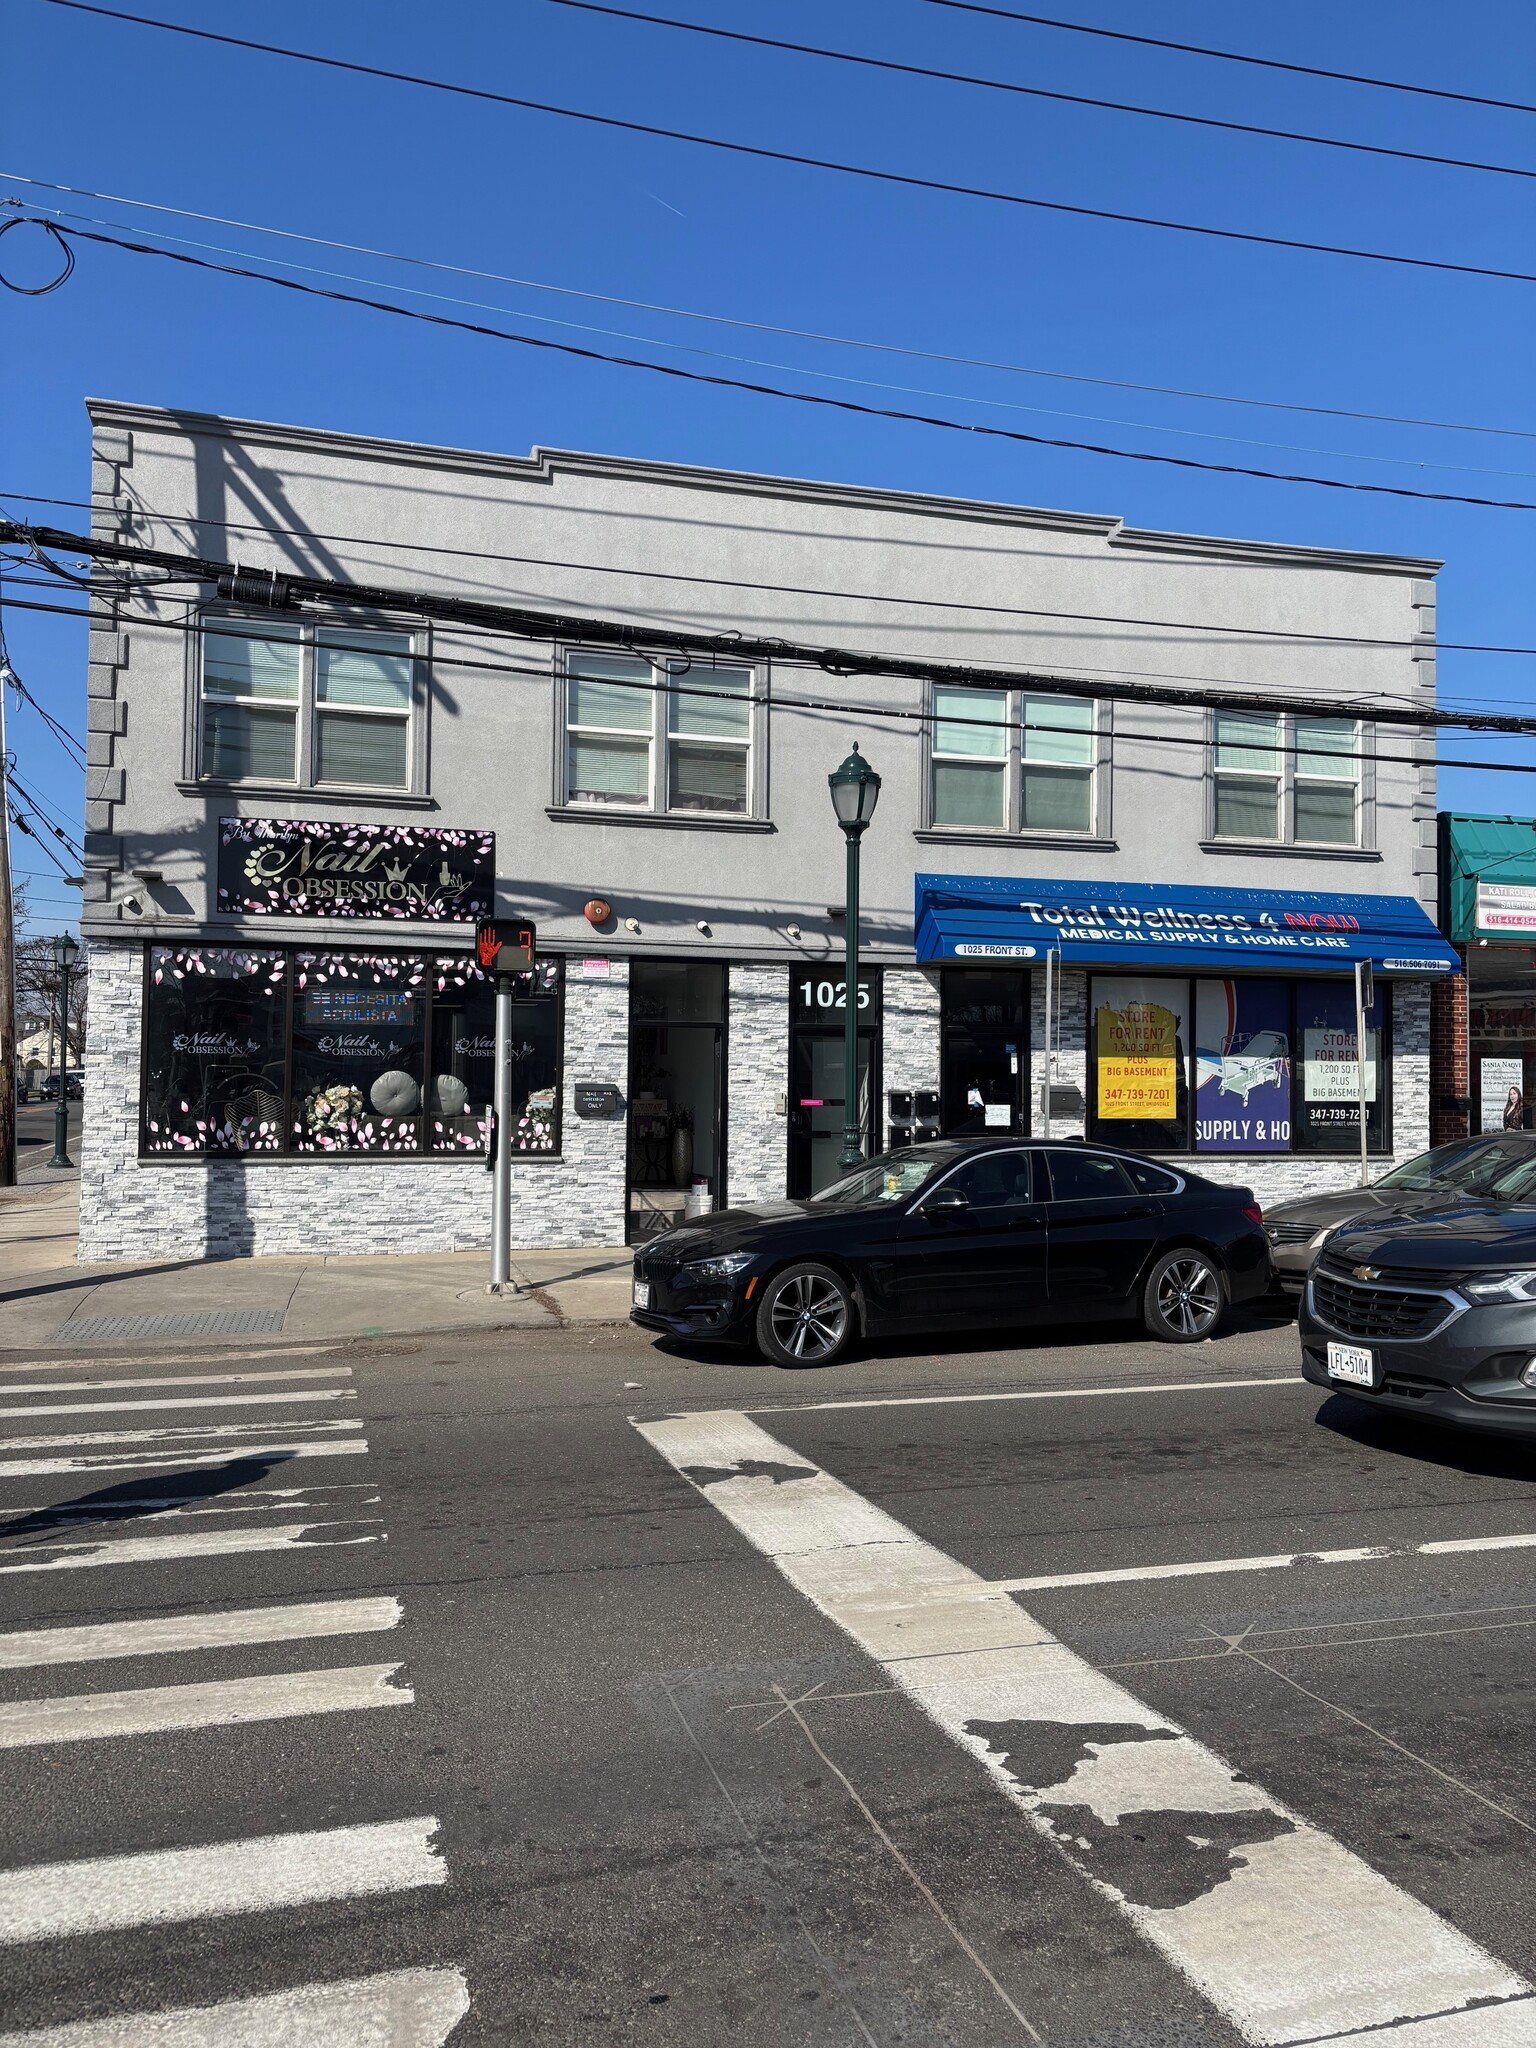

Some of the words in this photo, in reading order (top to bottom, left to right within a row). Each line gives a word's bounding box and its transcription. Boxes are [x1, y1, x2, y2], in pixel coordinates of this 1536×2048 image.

[256, 841, 386, 877] Nail
[282, 877, 428, 901] OBSESSION
[1488, 887, 1507, 896] KATI
[1500, 901, 1527, 910] SALAD
[1019, 902, 1107, 927] Total
[1108, 906, 1252, 931] Wellness
[1259, 912, 1279, 932] 4
[1283, 912, 1361, 935] NOW
[1059, 928, 1149, 942] MEDICAL
[1149, 932, 1219, 944] SUPPLY
[1224, 934, 1242, 945] &
[1242, 935, 1299, 947] HOME
[1299, 936, 1351, 949] CARE
[962, 945, 983, 955] 1025
[984, 945, 1014, 956] FRONT
[1015, 946, 1029, 956] ST.
[800, 981, 870, 1009] 1025
[1119, 1011, 1156, 1023] STORE
[177, 1031, 225, 1048] Nail
[1109, 1027, 1131, 1039] FOR
[1135, 1027, 1165, 1040] RENT
[322, 1034, 370, 1049] Nail
[459, 1035, 496, 1050] Nai
[1323, 1034, 1358, 1046] STORE
[187, 1046, 244, 1055] OBSESSION
[331, 1047, 386, 1057] OBSESSION
[468, 1049, 519, 1057] OBSESN
[1114, 1043, 1136, 1053] 1,200
[1139, 1043, 1150, 1053] SQ
[1152, 1043, 1161, 1052] FT
[1127, 1056, 1148, 1064] PLUS
[1314, 1049, 1335, 1061] FOR
[1338, 1050, 1359, 1061] REN
[1106, 1067, 1121, 1076] BIG
[1124, 1067, 1168, 1076] BASEMENT
[1319, 1064, 1339, 1074] 1,200
[1341, 1064, 1351, 1074] SQ
[1330, 1076, 1350, 1086] PLUS
[1105, 1088, 1170, 1100] 347-739-7201
[1312, 1088, 1326, 1097] BIG
[1310, 1109, 1370, 1120] 347-739-721
[1195, 1120, 1250, 1141] SUPPLY
[1255, 1121, 1267, 1140] &
[1271, 1121, 1290, 1140] HO
